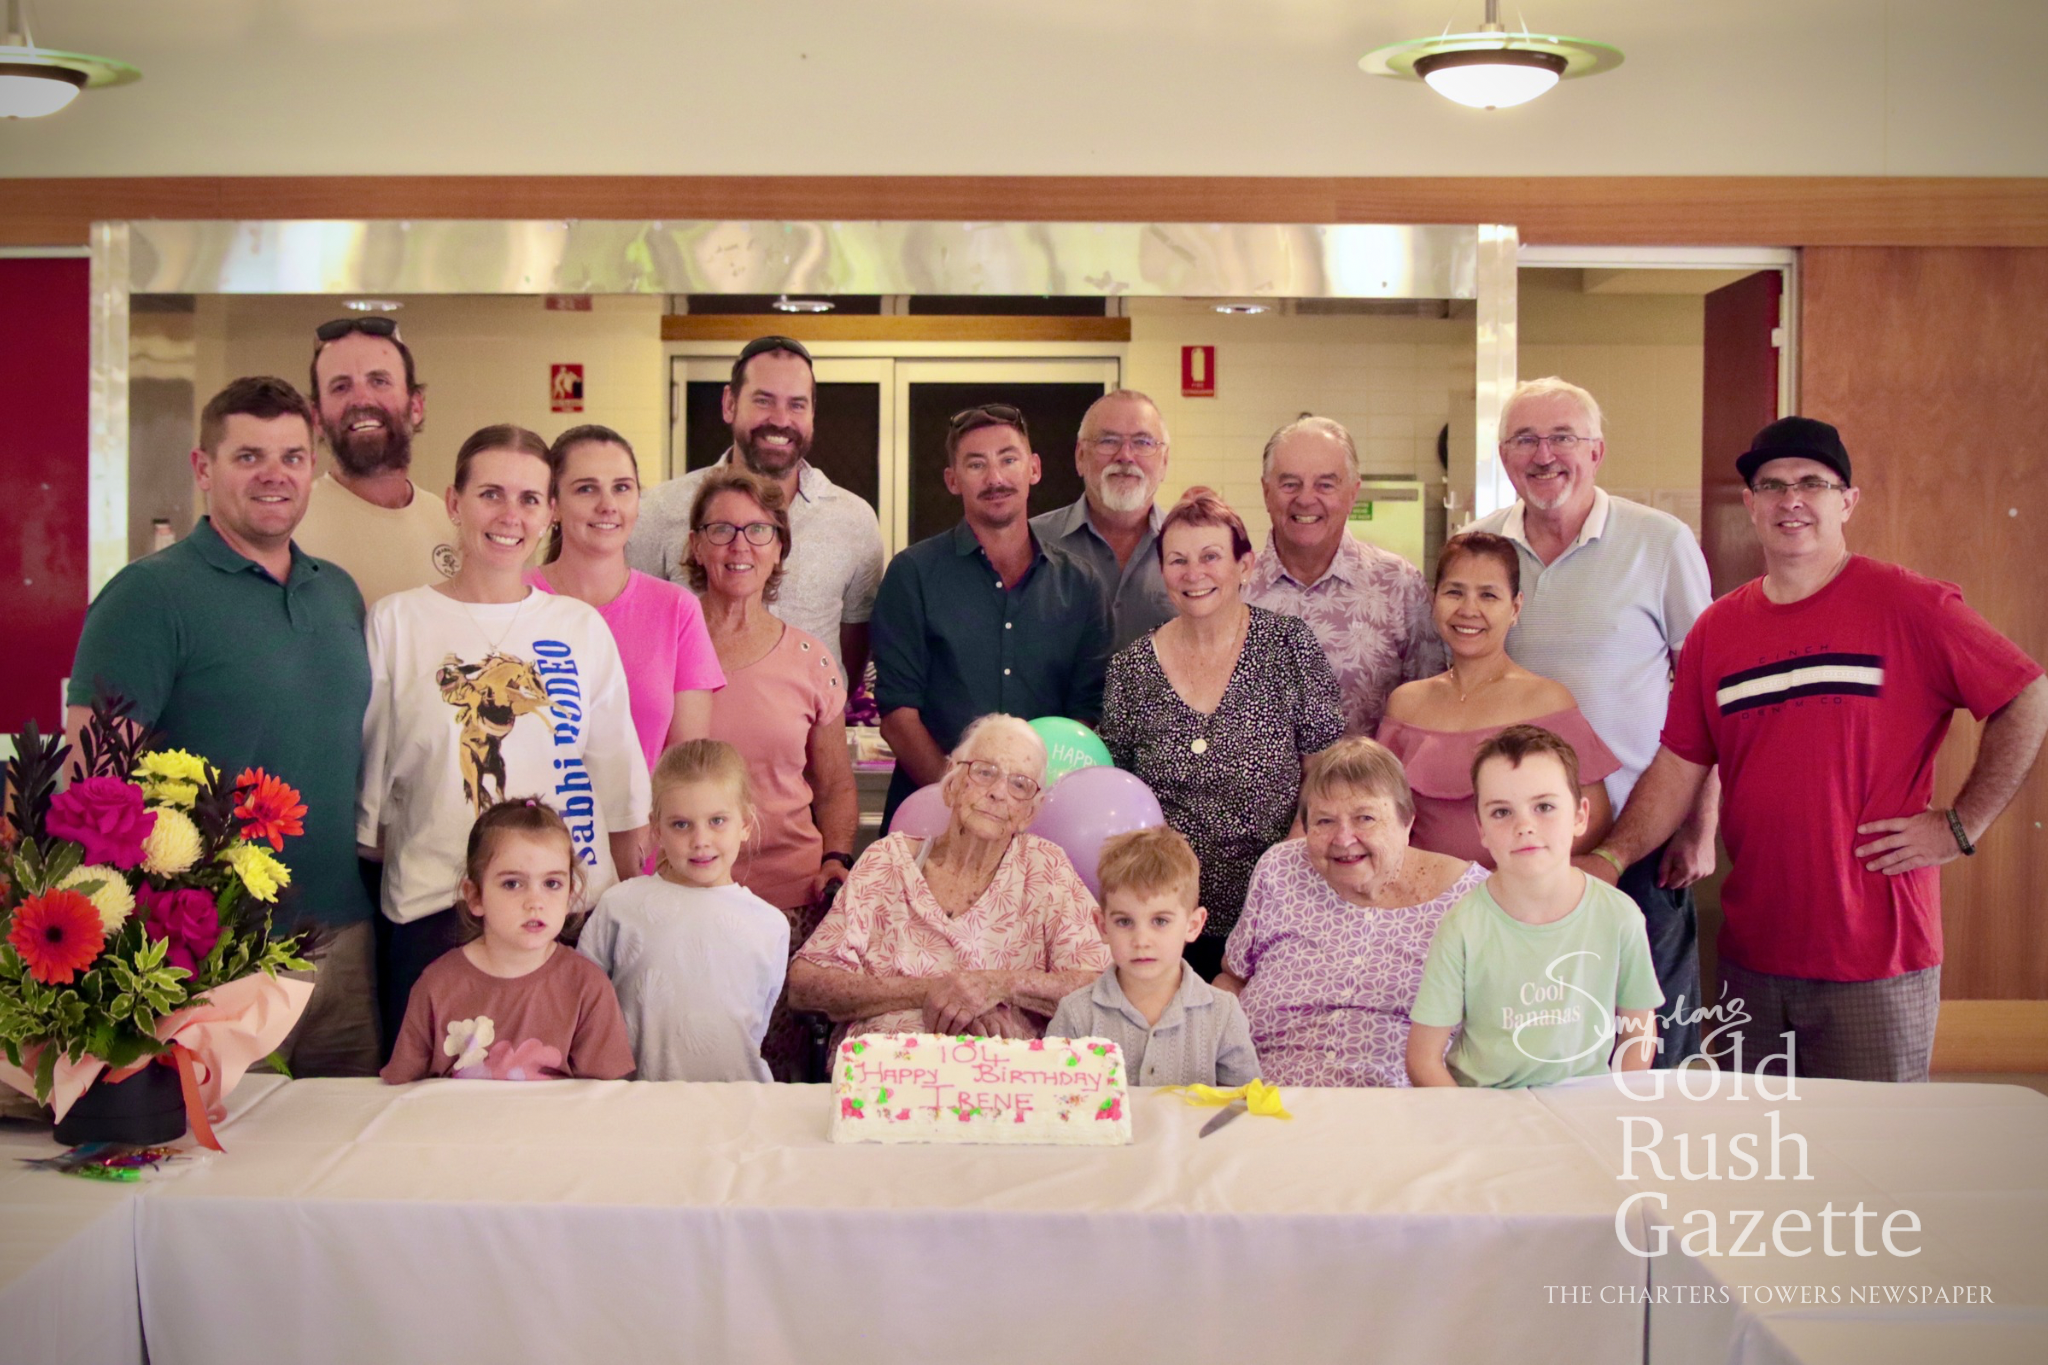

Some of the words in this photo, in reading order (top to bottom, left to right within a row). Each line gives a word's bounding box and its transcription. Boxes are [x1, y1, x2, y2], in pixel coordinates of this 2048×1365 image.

[1758, 644, 1829, 664] CINCH
[1519, 975, 1565, 1006] Cool
[1501, 1003, 1581, 1031] Bananas
[940, 1043, 1011, 1067] 104
[919, 1084, 1034, 1111] IRENE
